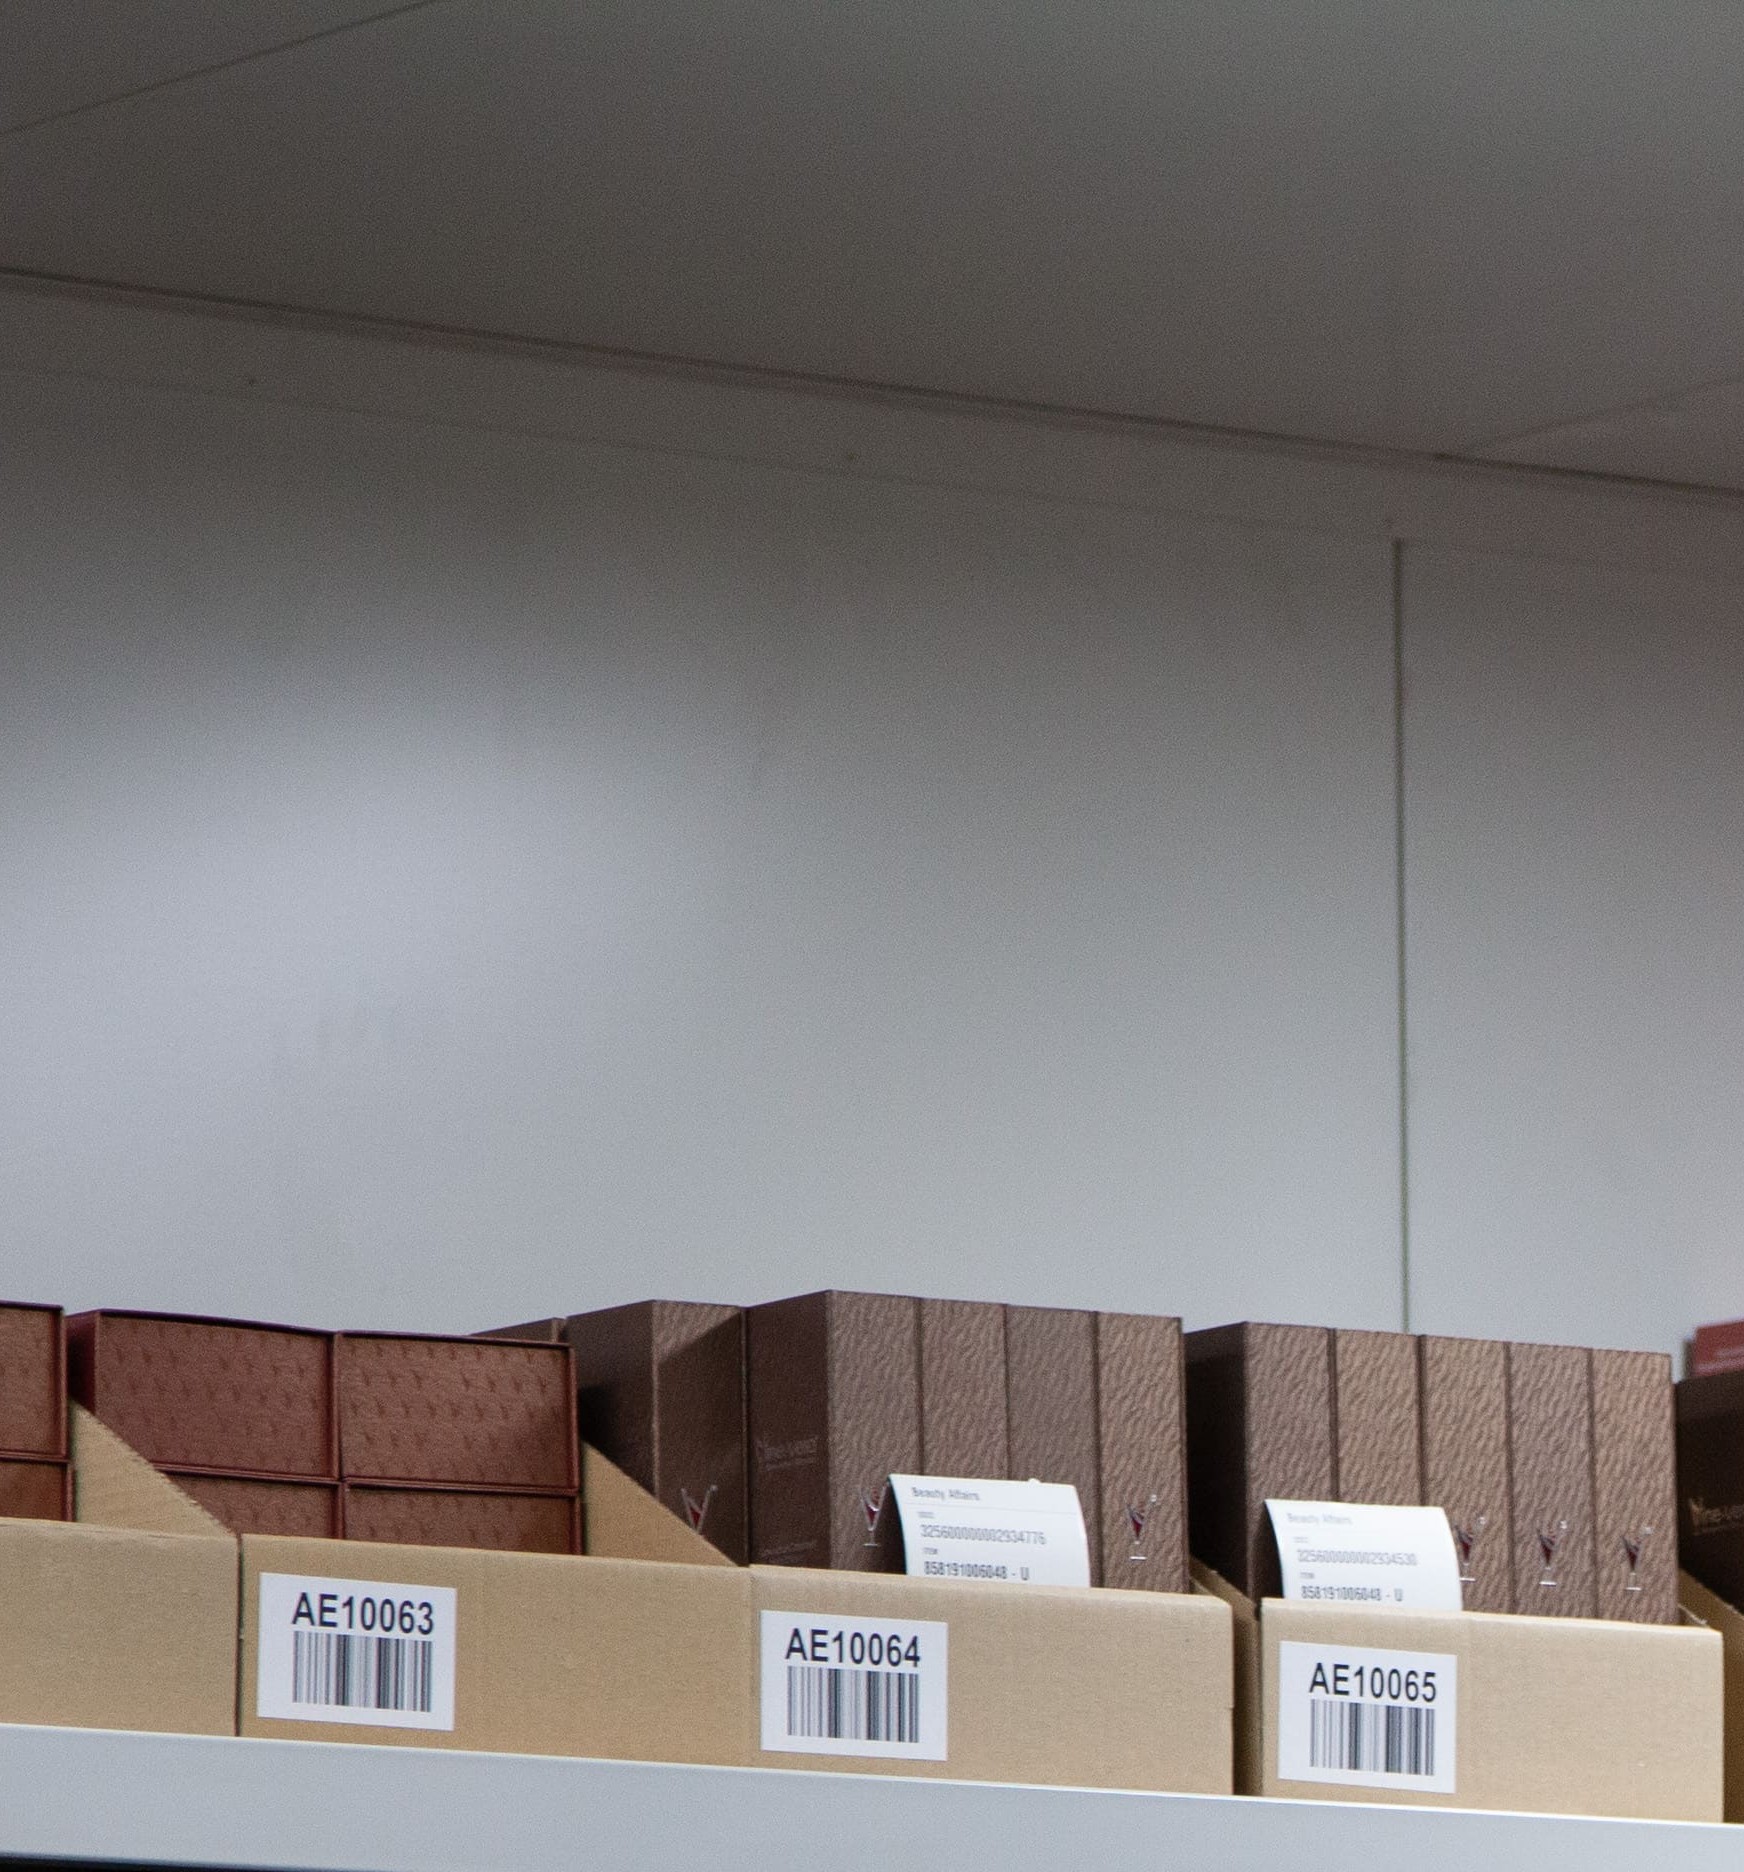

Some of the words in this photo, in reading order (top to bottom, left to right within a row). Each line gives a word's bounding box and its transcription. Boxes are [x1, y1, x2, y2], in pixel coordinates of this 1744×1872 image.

[291, 1591, 434, 1636] AE10063
[785, 1627, 921, 1668] AE10064
[1309, 1662, 1437, 1703] AE10065
